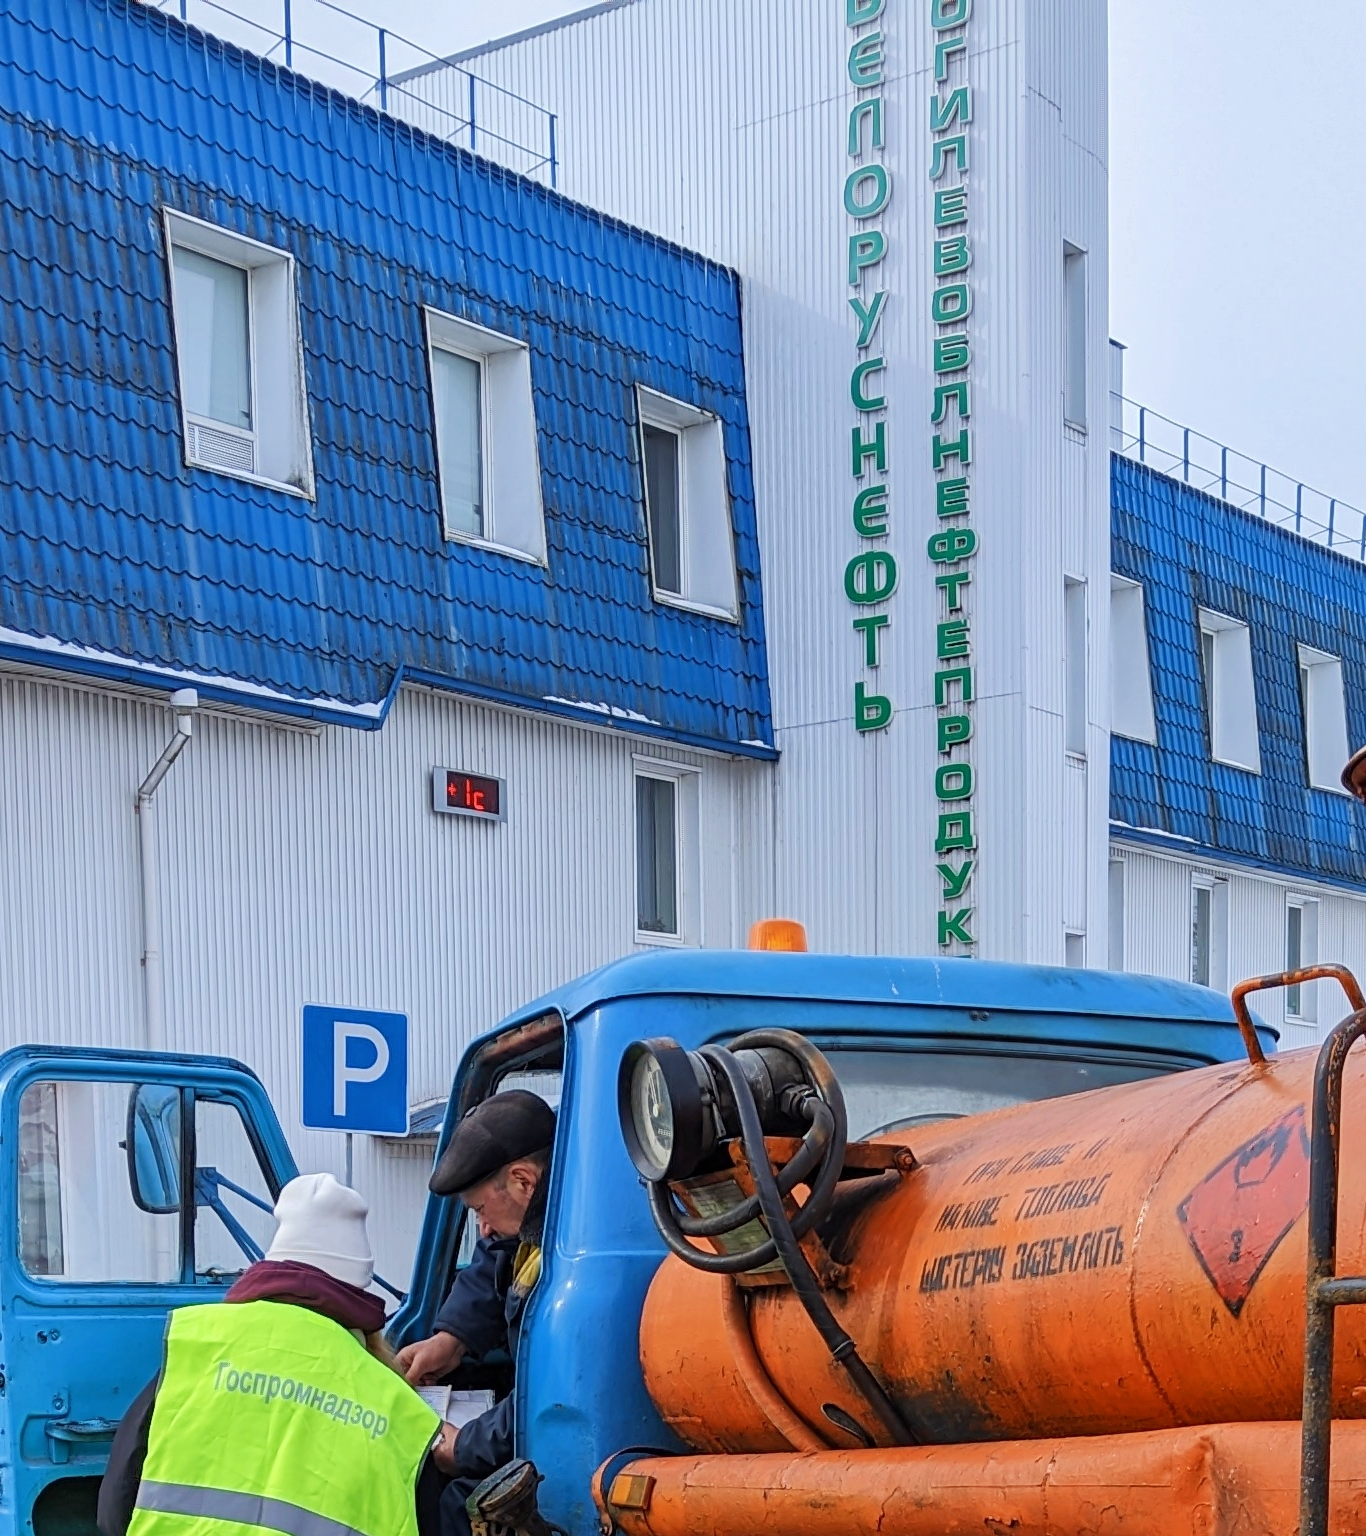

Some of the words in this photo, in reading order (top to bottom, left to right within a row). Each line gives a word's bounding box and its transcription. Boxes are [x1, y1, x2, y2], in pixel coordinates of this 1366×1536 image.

[928, 0, 978, 958] ОГИЛЕВОБЛНЕФТЕПРОДУК
[334, 1021, 389, 1116] P
[934, 1193, 1010, 1233] НАЛИВЕ
[1015, 1172, 1112, 1222] ТОПЛИВА
[919, 1245, 1007, 1294] ЦИСТЕРНУ
[1012, 1226, 1125, 1280] ЗАЗЕМЛИТЬ
[213, 1360, 389, 1440] Госпромнадзор
